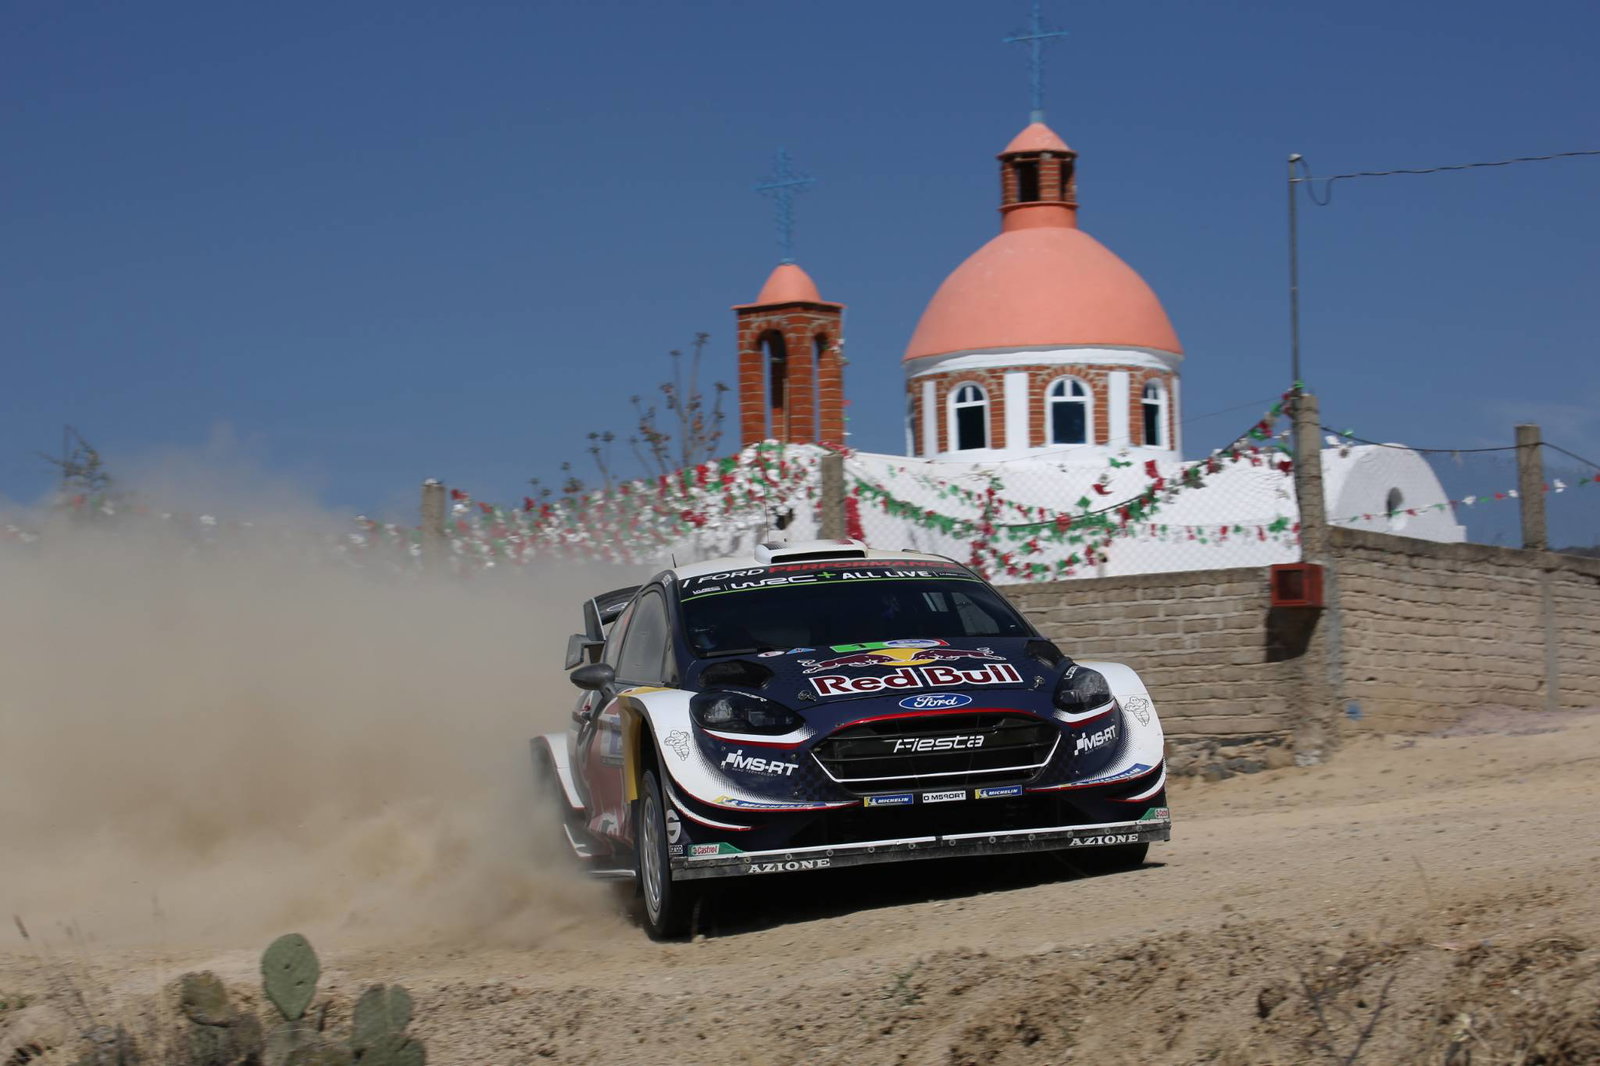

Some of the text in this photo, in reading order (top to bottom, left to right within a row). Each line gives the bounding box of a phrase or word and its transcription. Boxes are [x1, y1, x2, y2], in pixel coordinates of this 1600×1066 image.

[698, 561, 957, 583] FORD PERFORMANCE
[842, 571, 881, 580] ALL
[884, 570, 932, 578] LIVE
[810, 664, 1022, 696] Red Bull
[913, 694, 958, 708] Ford
[893, 735, 985, 753] Fiesta
[988, 787, 1018, 796] MICHELIN
[877, 796, 909, 804] MICHELIN
[1069, 833, 1139, 847] AZIONE
[748, 858, 831, 874] AZIONE
